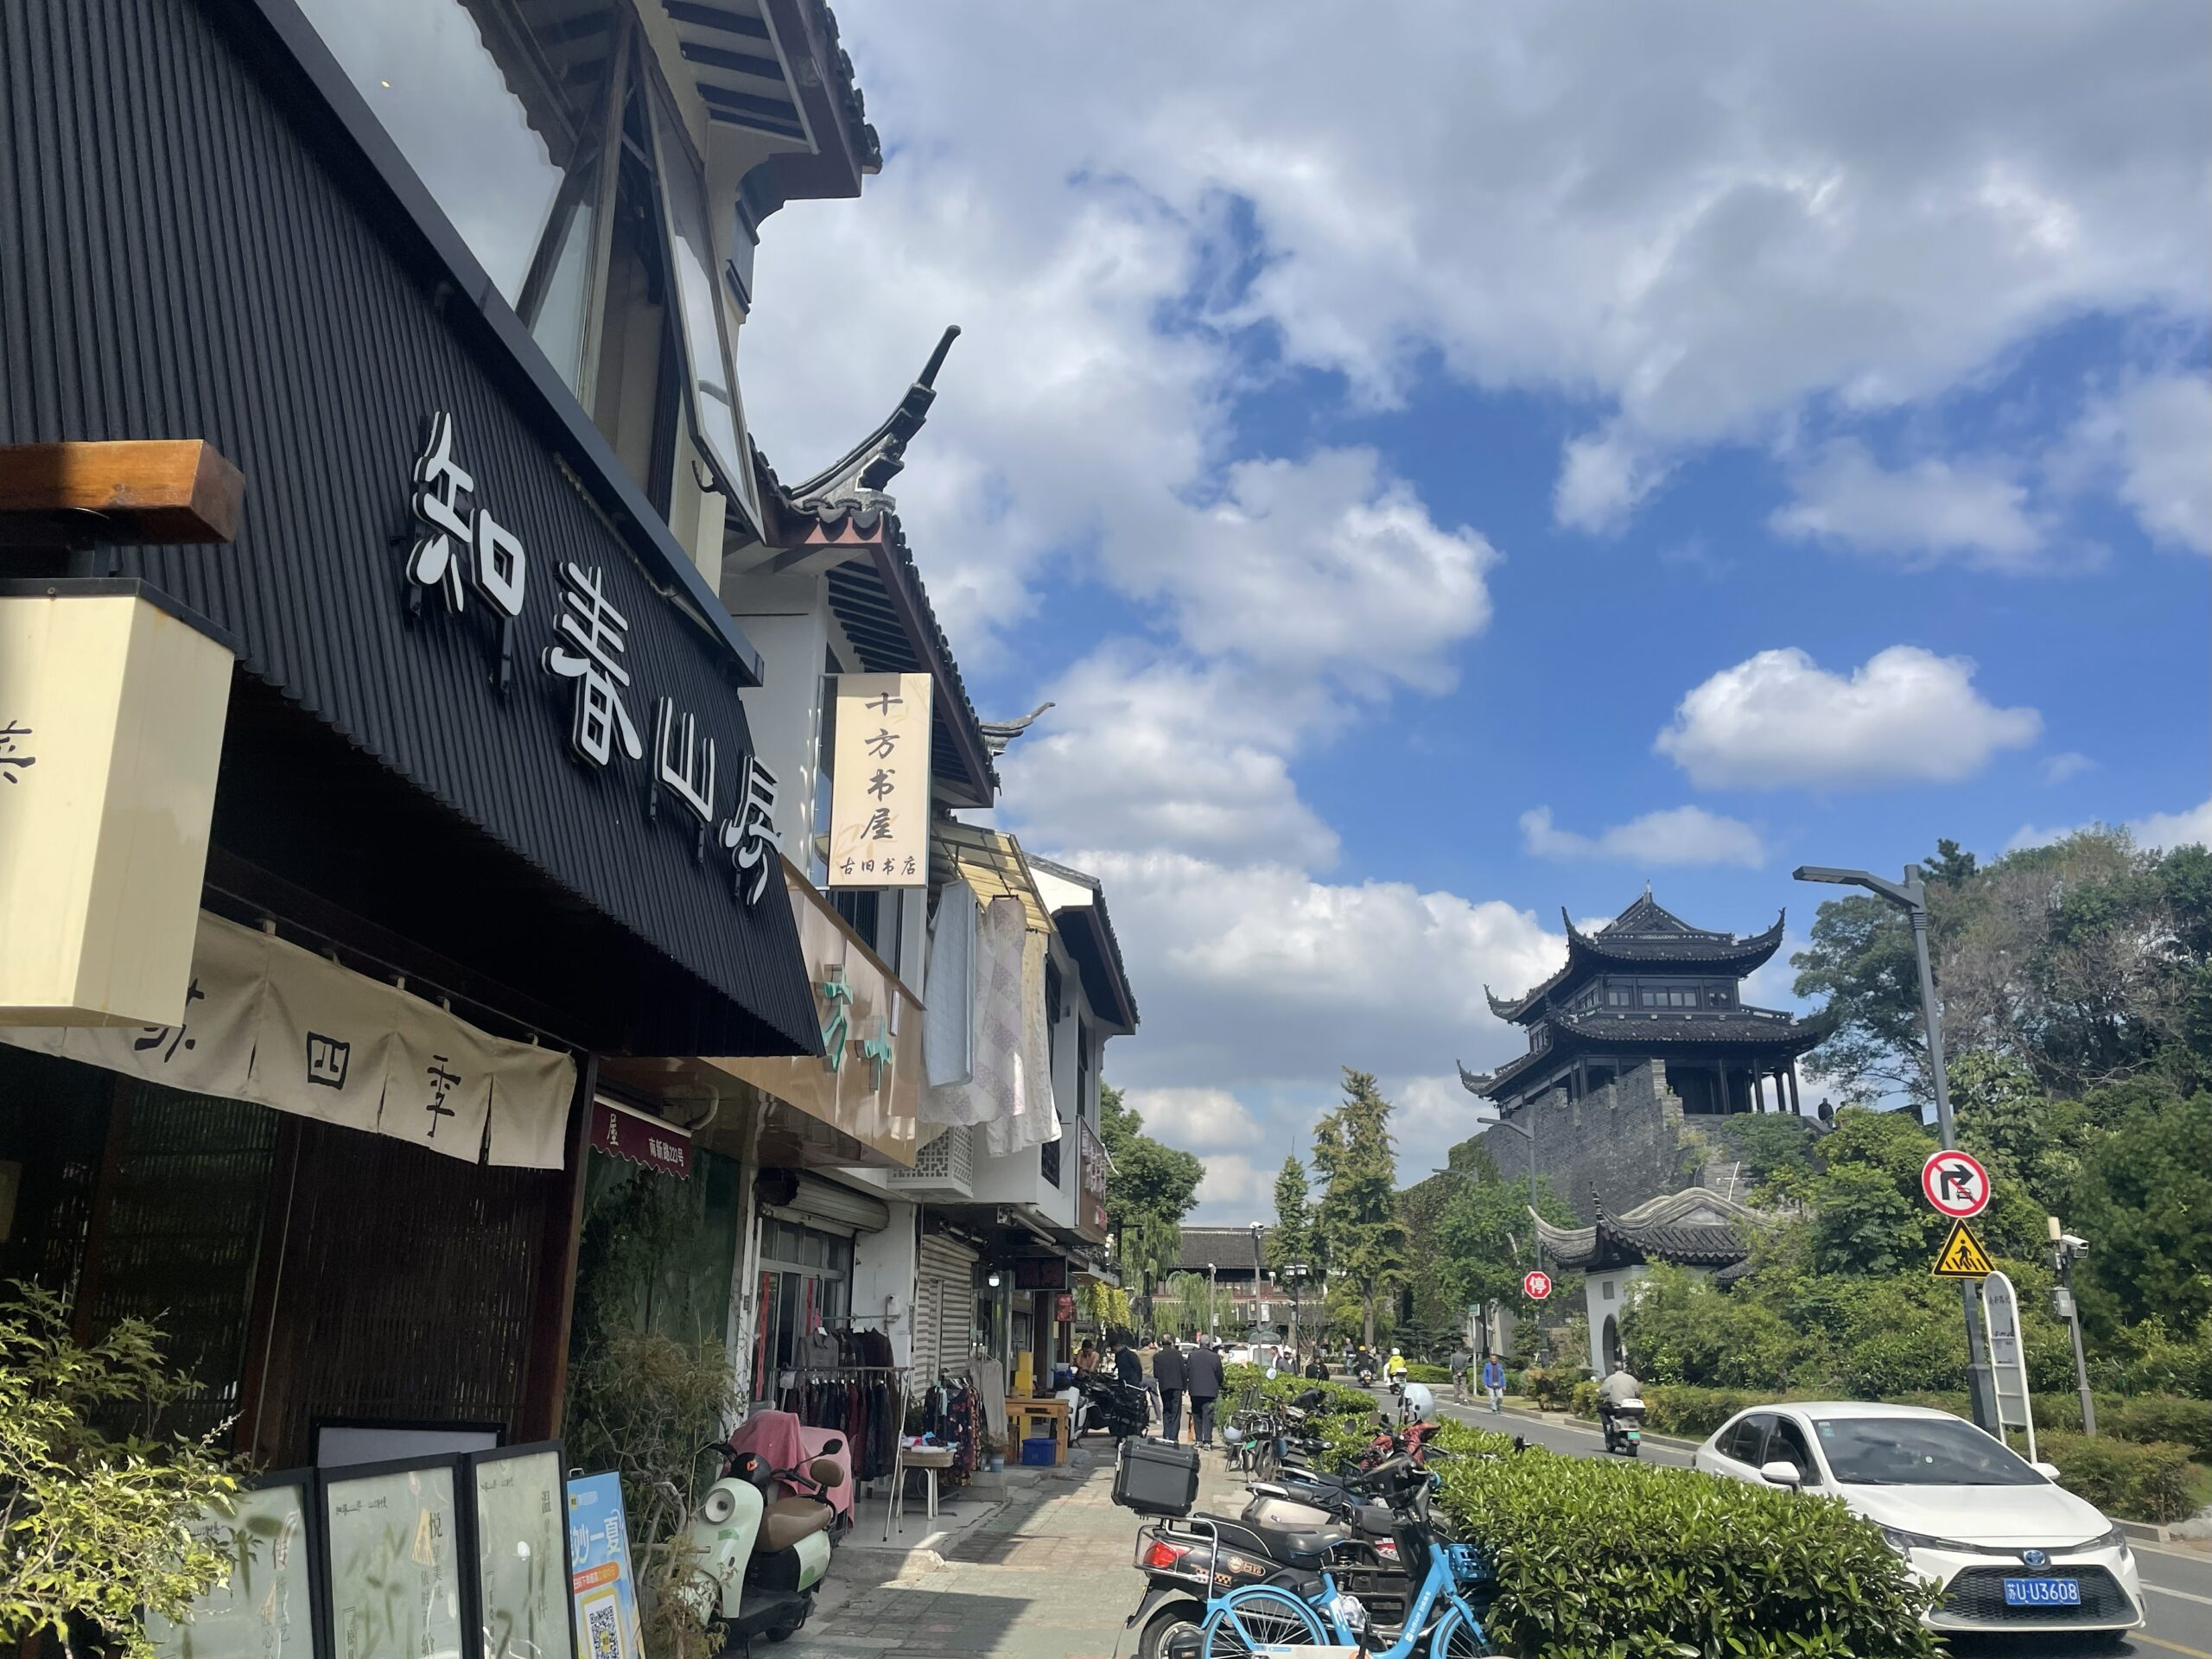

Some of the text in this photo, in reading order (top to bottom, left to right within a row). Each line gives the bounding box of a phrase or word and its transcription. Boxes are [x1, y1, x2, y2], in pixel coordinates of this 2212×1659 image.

[861, 692, 903, 840] 十方书屋
[840, 856, 916, 876] 古旧书店
[1529, 1276, 1547, 1294] 停
